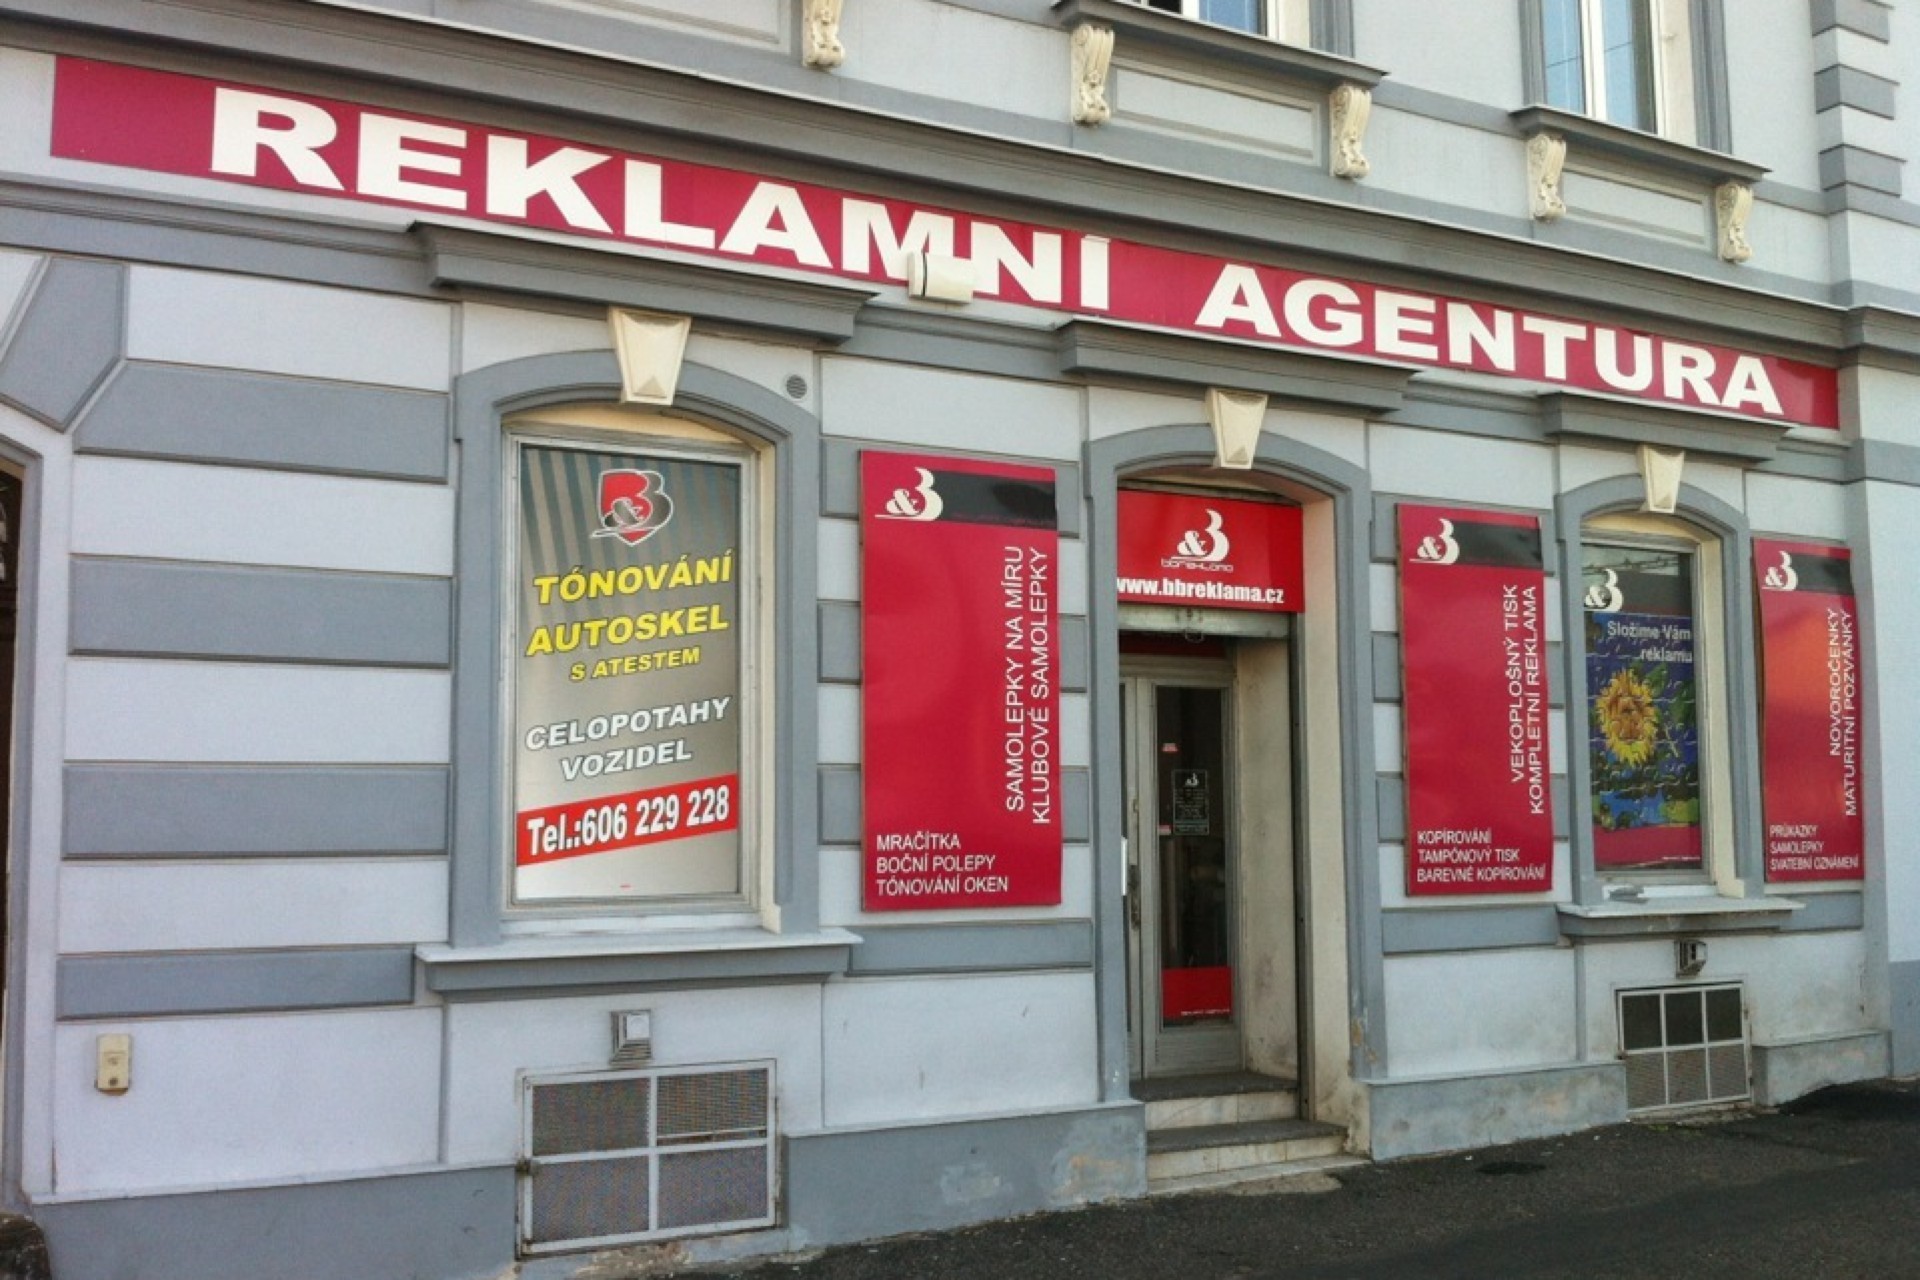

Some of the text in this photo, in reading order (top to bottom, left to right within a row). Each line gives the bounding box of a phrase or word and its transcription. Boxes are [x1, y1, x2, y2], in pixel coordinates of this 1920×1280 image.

[1195, 264, 1784, 415] AGENTURA
[533, 549, 733, 604] TÓNOVÁNÍ
[525, 604, 730, 657] AUTOSKEL
[1502, 584, 1519, 631] TISK
[570, 646, 701, 681] S ATESTEM
[1640, 646, 1693, 663] reklamu
[1001, 546, 1024, 812] SAMOLEPKY NA MÍRU
[1027, 546, 1050, 825] KLUBOVÉ SAMOLEPKY
[1522, 586, 1545, 814] KOMPLETNÍ REKLAMA
[1827, 608, 1841, 756] NOVOROČENKY
[525, 696, 732, 750] CELOPOTAHY
[1841, 610, 1857, 816] MATURITNÍ POZVÁNKY
[560, 739, 693, 782] VOZIDEL
[634, 794, 680, 837] 229
[686, 785, 730, 828] 228
[876, 831, 962, 851] MRAČÍTKA
[1416, 827, 1492, 845] KOPÍROVÁNÍ
[1416, 845, 1520, 864] TAMPÓNOVÝ TISK
[1770, 840, 1824, 854] SAMOLEPKY
[876, 853, 996, 874] BOČNÍ POLEPY
[876, 874, 1009, 896] TÓNOVÁNÍ OKEN
[1416, 863, 1546, 883] BAREVNÉ KOPÍROVÁNÍ
